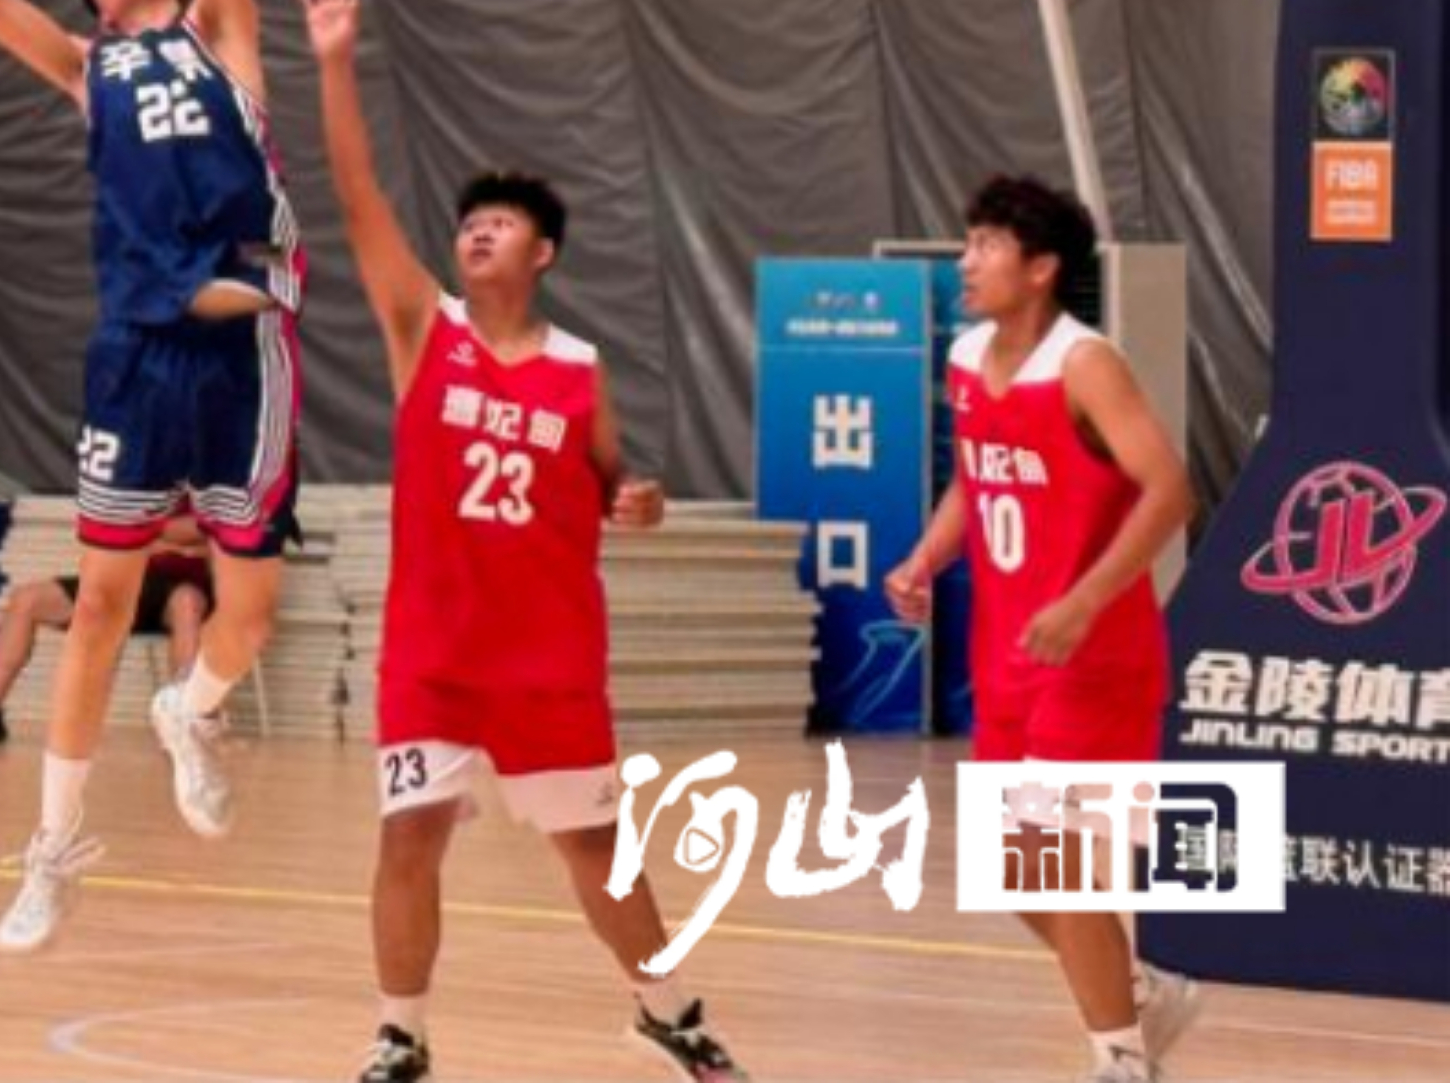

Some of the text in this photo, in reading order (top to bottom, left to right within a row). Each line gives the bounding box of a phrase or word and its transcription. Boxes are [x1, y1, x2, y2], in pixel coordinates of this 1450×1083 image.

[136, 79, 211, 143] 22
[458, 441, 535, 526] 23
[813, 394, 873, 591] 出口
[978, 492, 1025, 574] 10
[385, 747, 427, 797] 23
